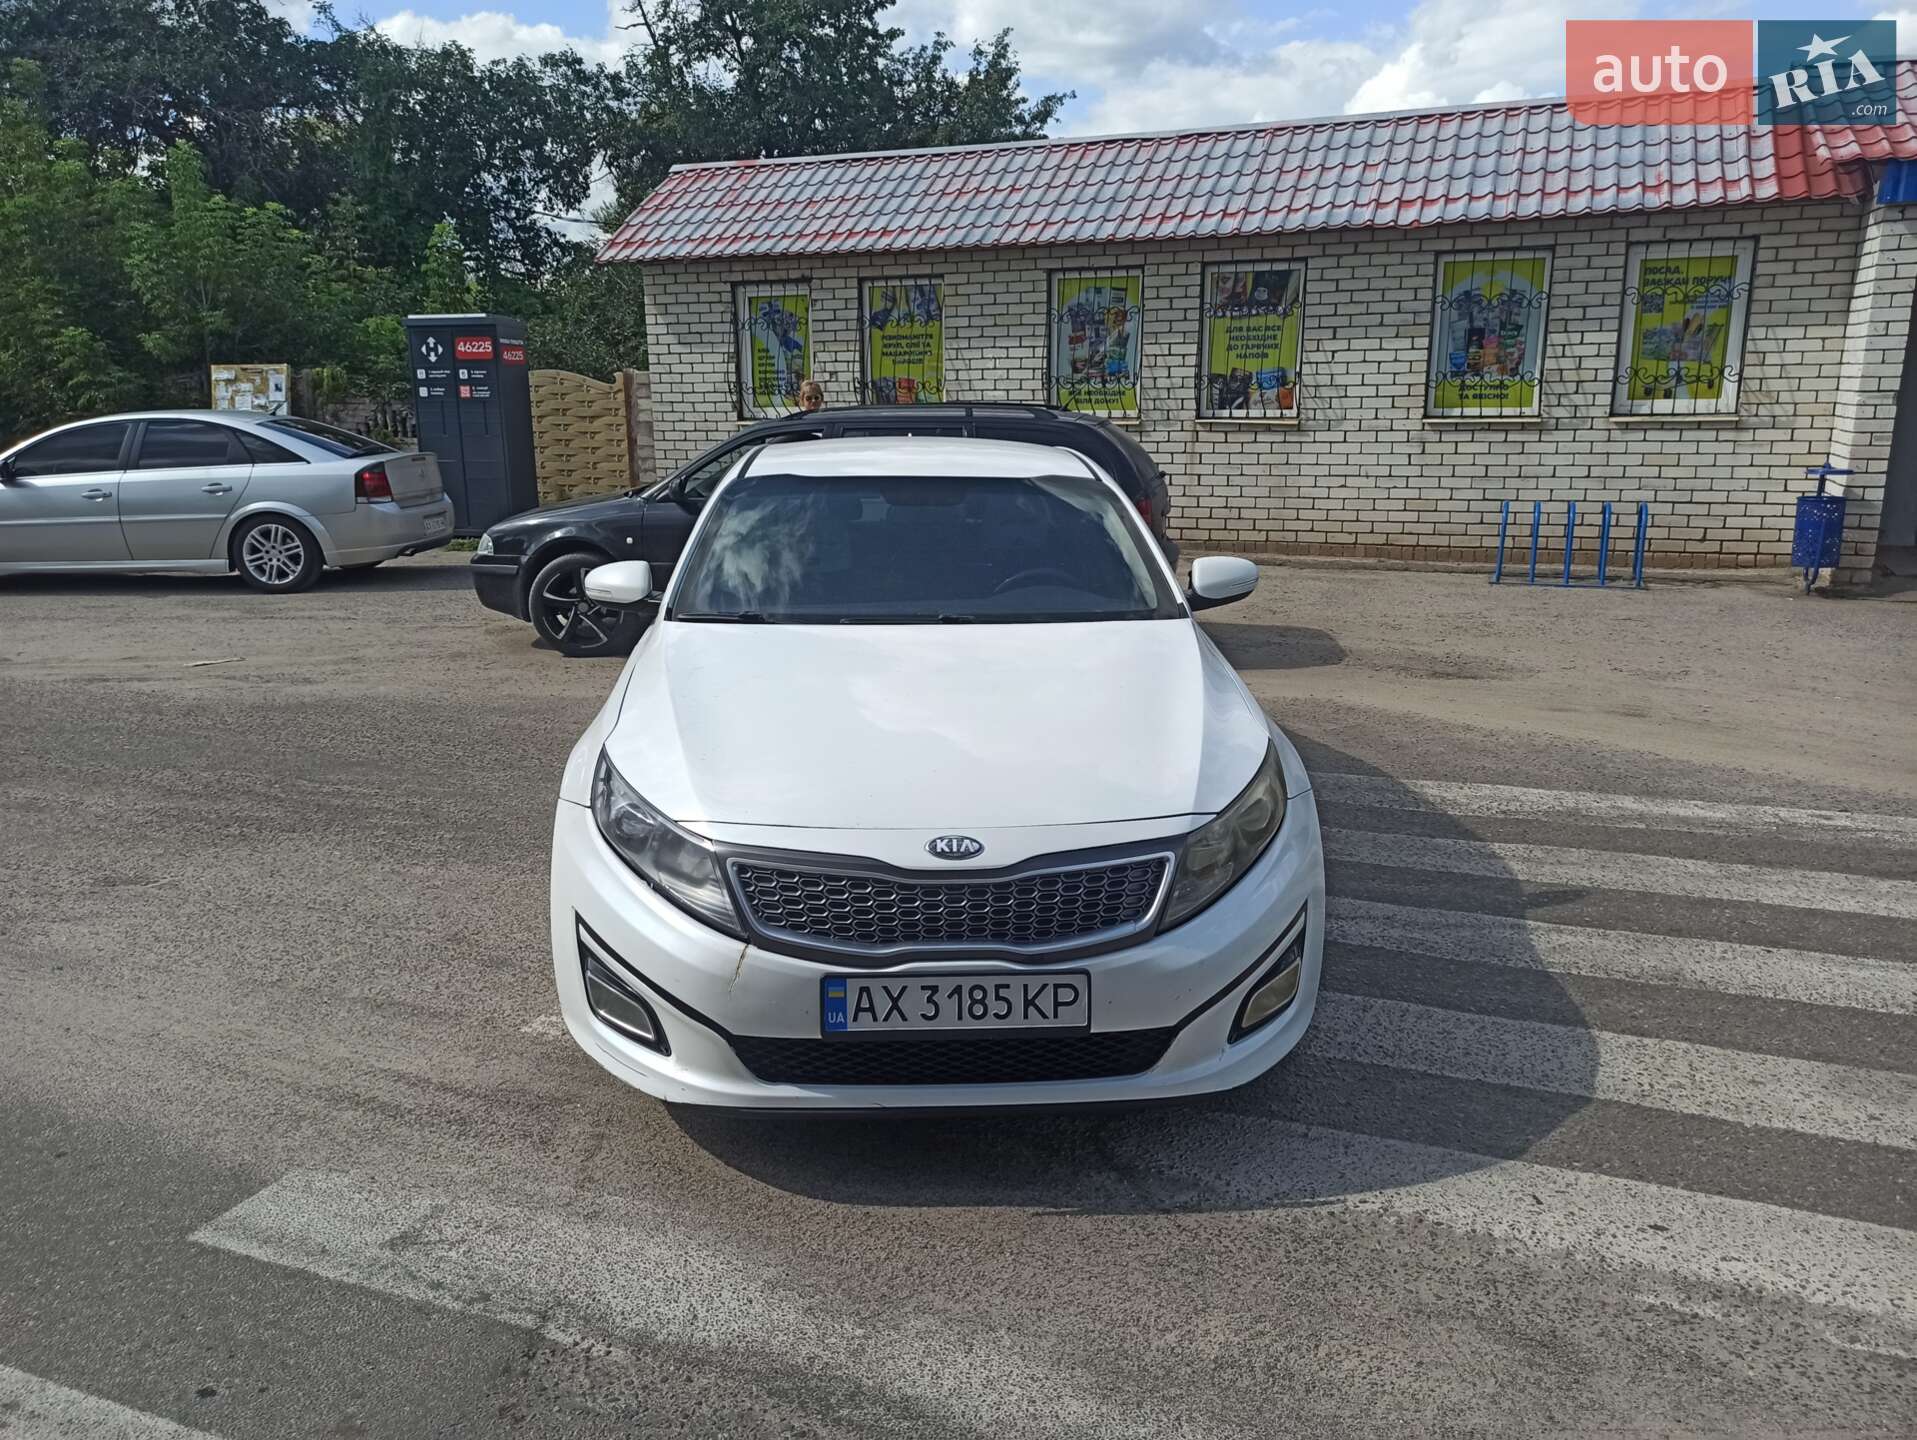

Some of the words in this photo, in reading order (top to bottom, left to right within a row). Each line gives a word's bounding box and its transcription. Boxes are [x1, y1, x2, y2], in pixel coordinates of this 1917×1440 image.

[1226, 326, 1244, 334] ДЛЯ
[1246, 325, 1264, 333] ВАС
[458, 341, 492, 353] 46225
[503, 350, 525, 360] 46225
[936, 839, 975, 852] KIA
[852, 985, 908, 1023] AX
[919, 983, 1013, 1022] 3185
[1023, 983, 1081, 1021] KP
[828, 1011, 845, 1024] UA
